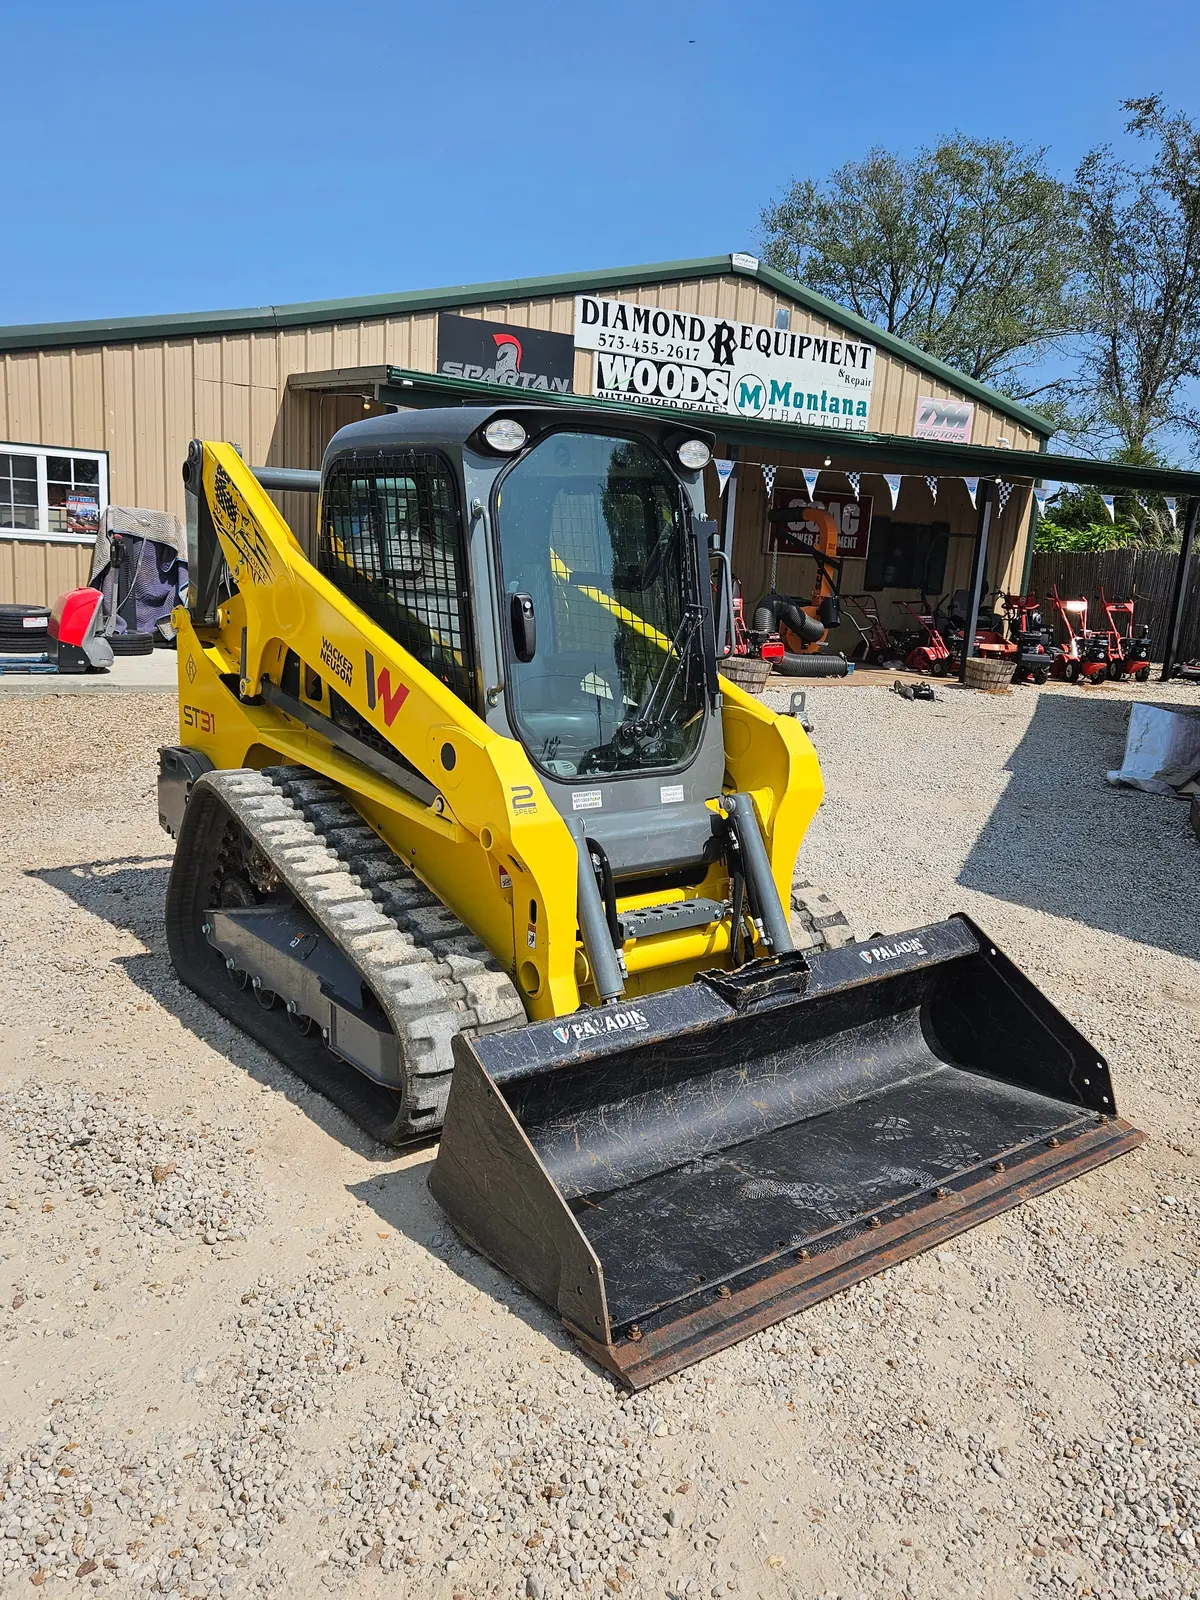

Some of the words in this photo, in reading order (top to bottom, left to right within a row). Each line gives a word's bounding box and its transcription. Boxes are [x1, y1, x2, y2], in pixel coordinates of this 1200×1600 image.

[580, 298, 706, 342] DIAMOND
[739, 325, 872, 370] EQUIPMENT
[598, 333, 701, 362] 573-455-2617
[442, 361, 570, 393] SPARTAN
[599, 352, 729, 404] WOODS
[838, 368, 846, 378] &
[845, 374, 873, 388] Repair
[769, 379, 867, 417] Montana
[768, 407, 867, 431] TRACTORS
[915, 428, 965, 441] TRACTORS
[320, 648, 352, 687] NEUSON
[322, 635, 353, 676] WACKER
[183, 705, 215, 735] ST31
[511, 785, 536, 809] 2
[513, 807, 538, 816] SPEED
[871, 938, 924, 960] PALADIN
[571, 1008, 648, 1040] PALADIN
